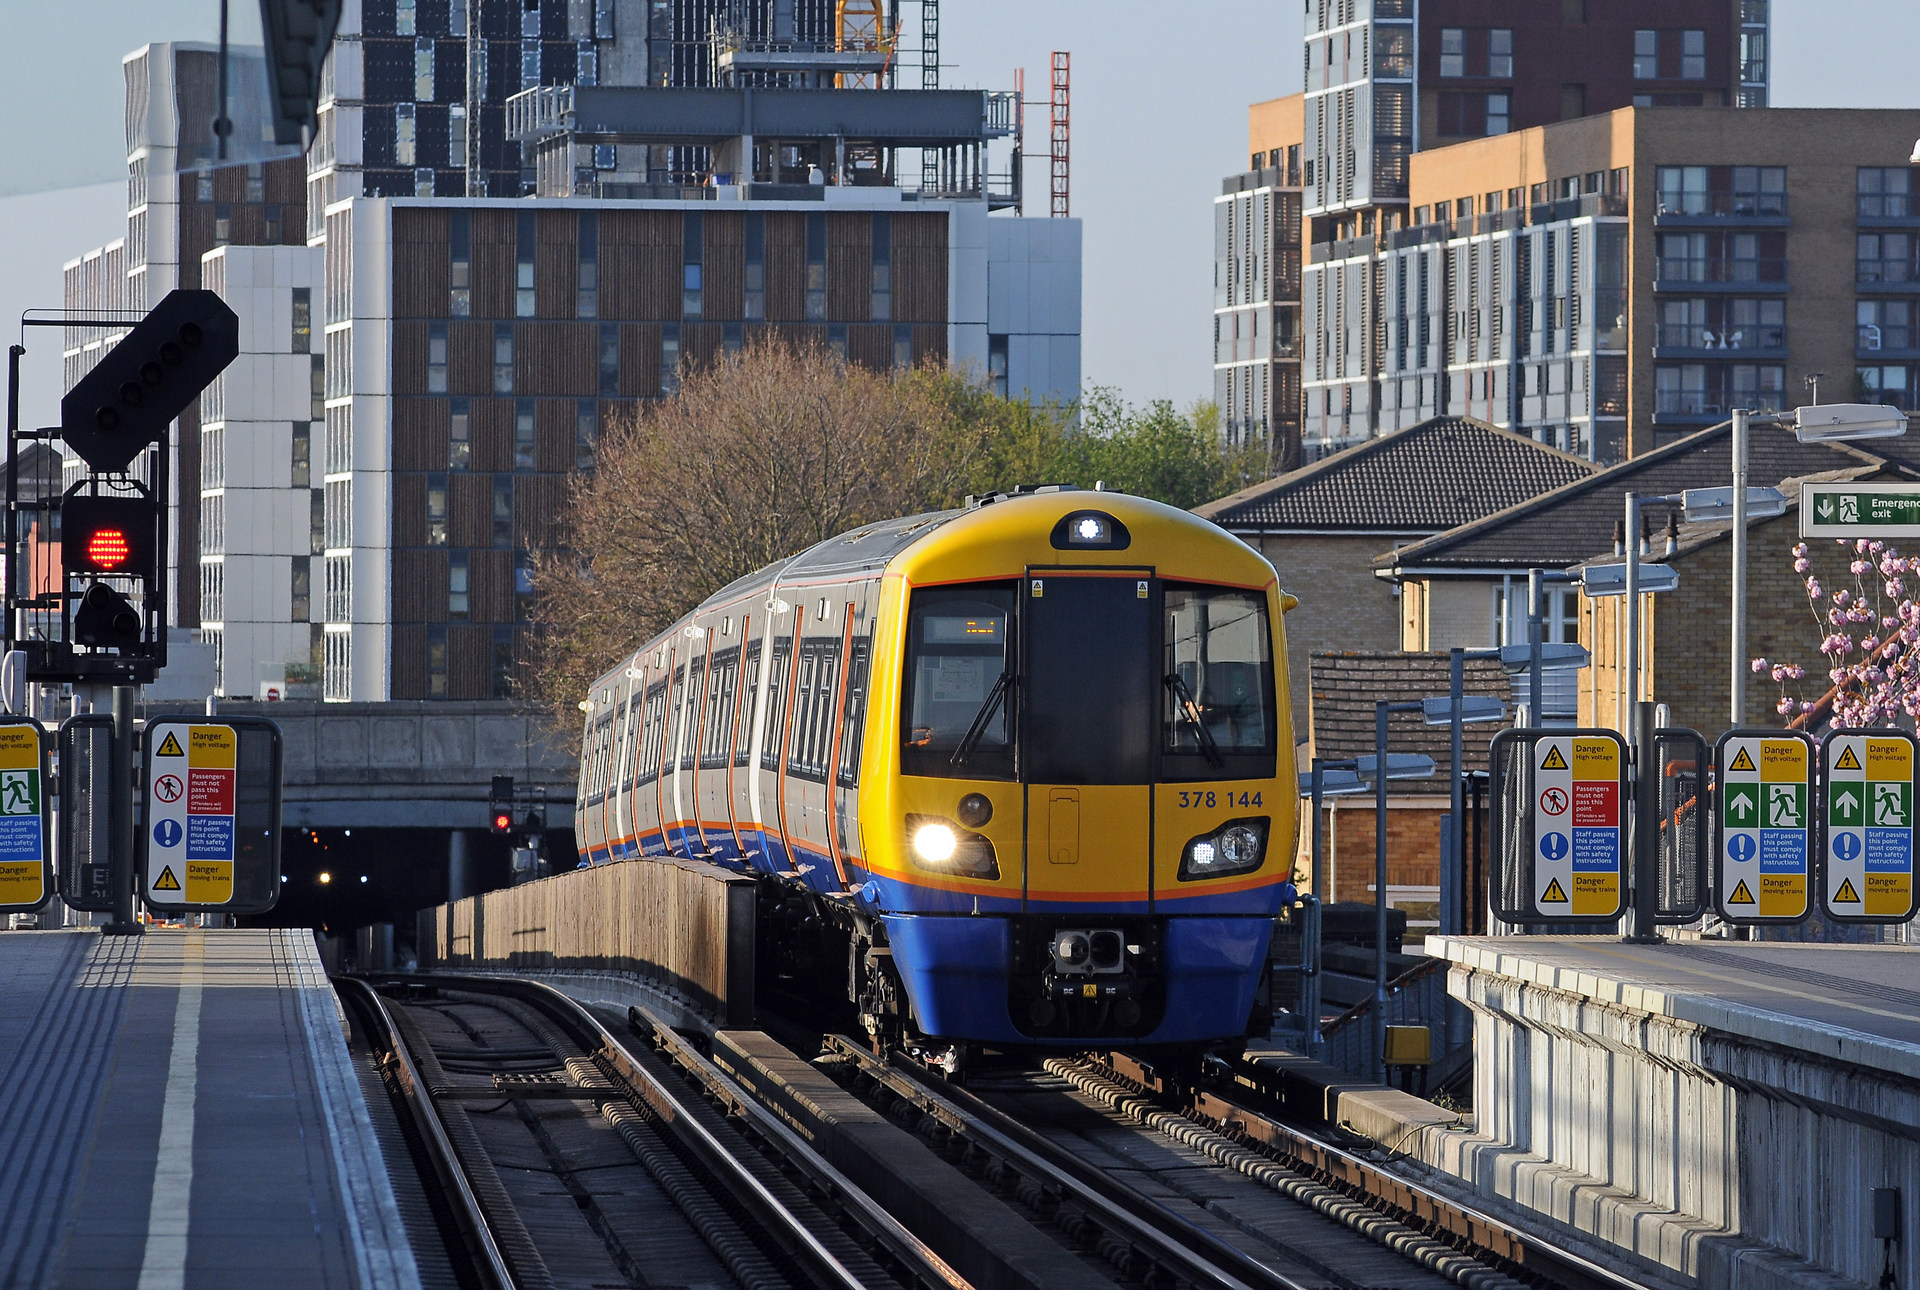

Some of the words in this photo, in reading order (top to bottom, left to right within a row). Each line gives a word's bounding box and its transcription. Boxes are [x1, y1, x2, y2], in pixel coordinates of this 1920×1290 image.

[1872, 510, 1891, 518] exit
[0, 734, 24, 742] anger
[192, 732, 222, 741] Danger
[1576, 745, 1604, 753] Danger
[1764, 746, 1793, 755] Danger
[1870, 745, 1898, 754] Danger
[1179, 792, 1216, 808] 378
[1227, 792, 1263, 808] 144
[0, 867, 28, 875] Danger
[190, 866, 218, 874] Danger
[1576, 877, 1605, 886] Danger
[1763, 879, 1792, 887] Danger
[1868, 878, 1897, 886] Danger
